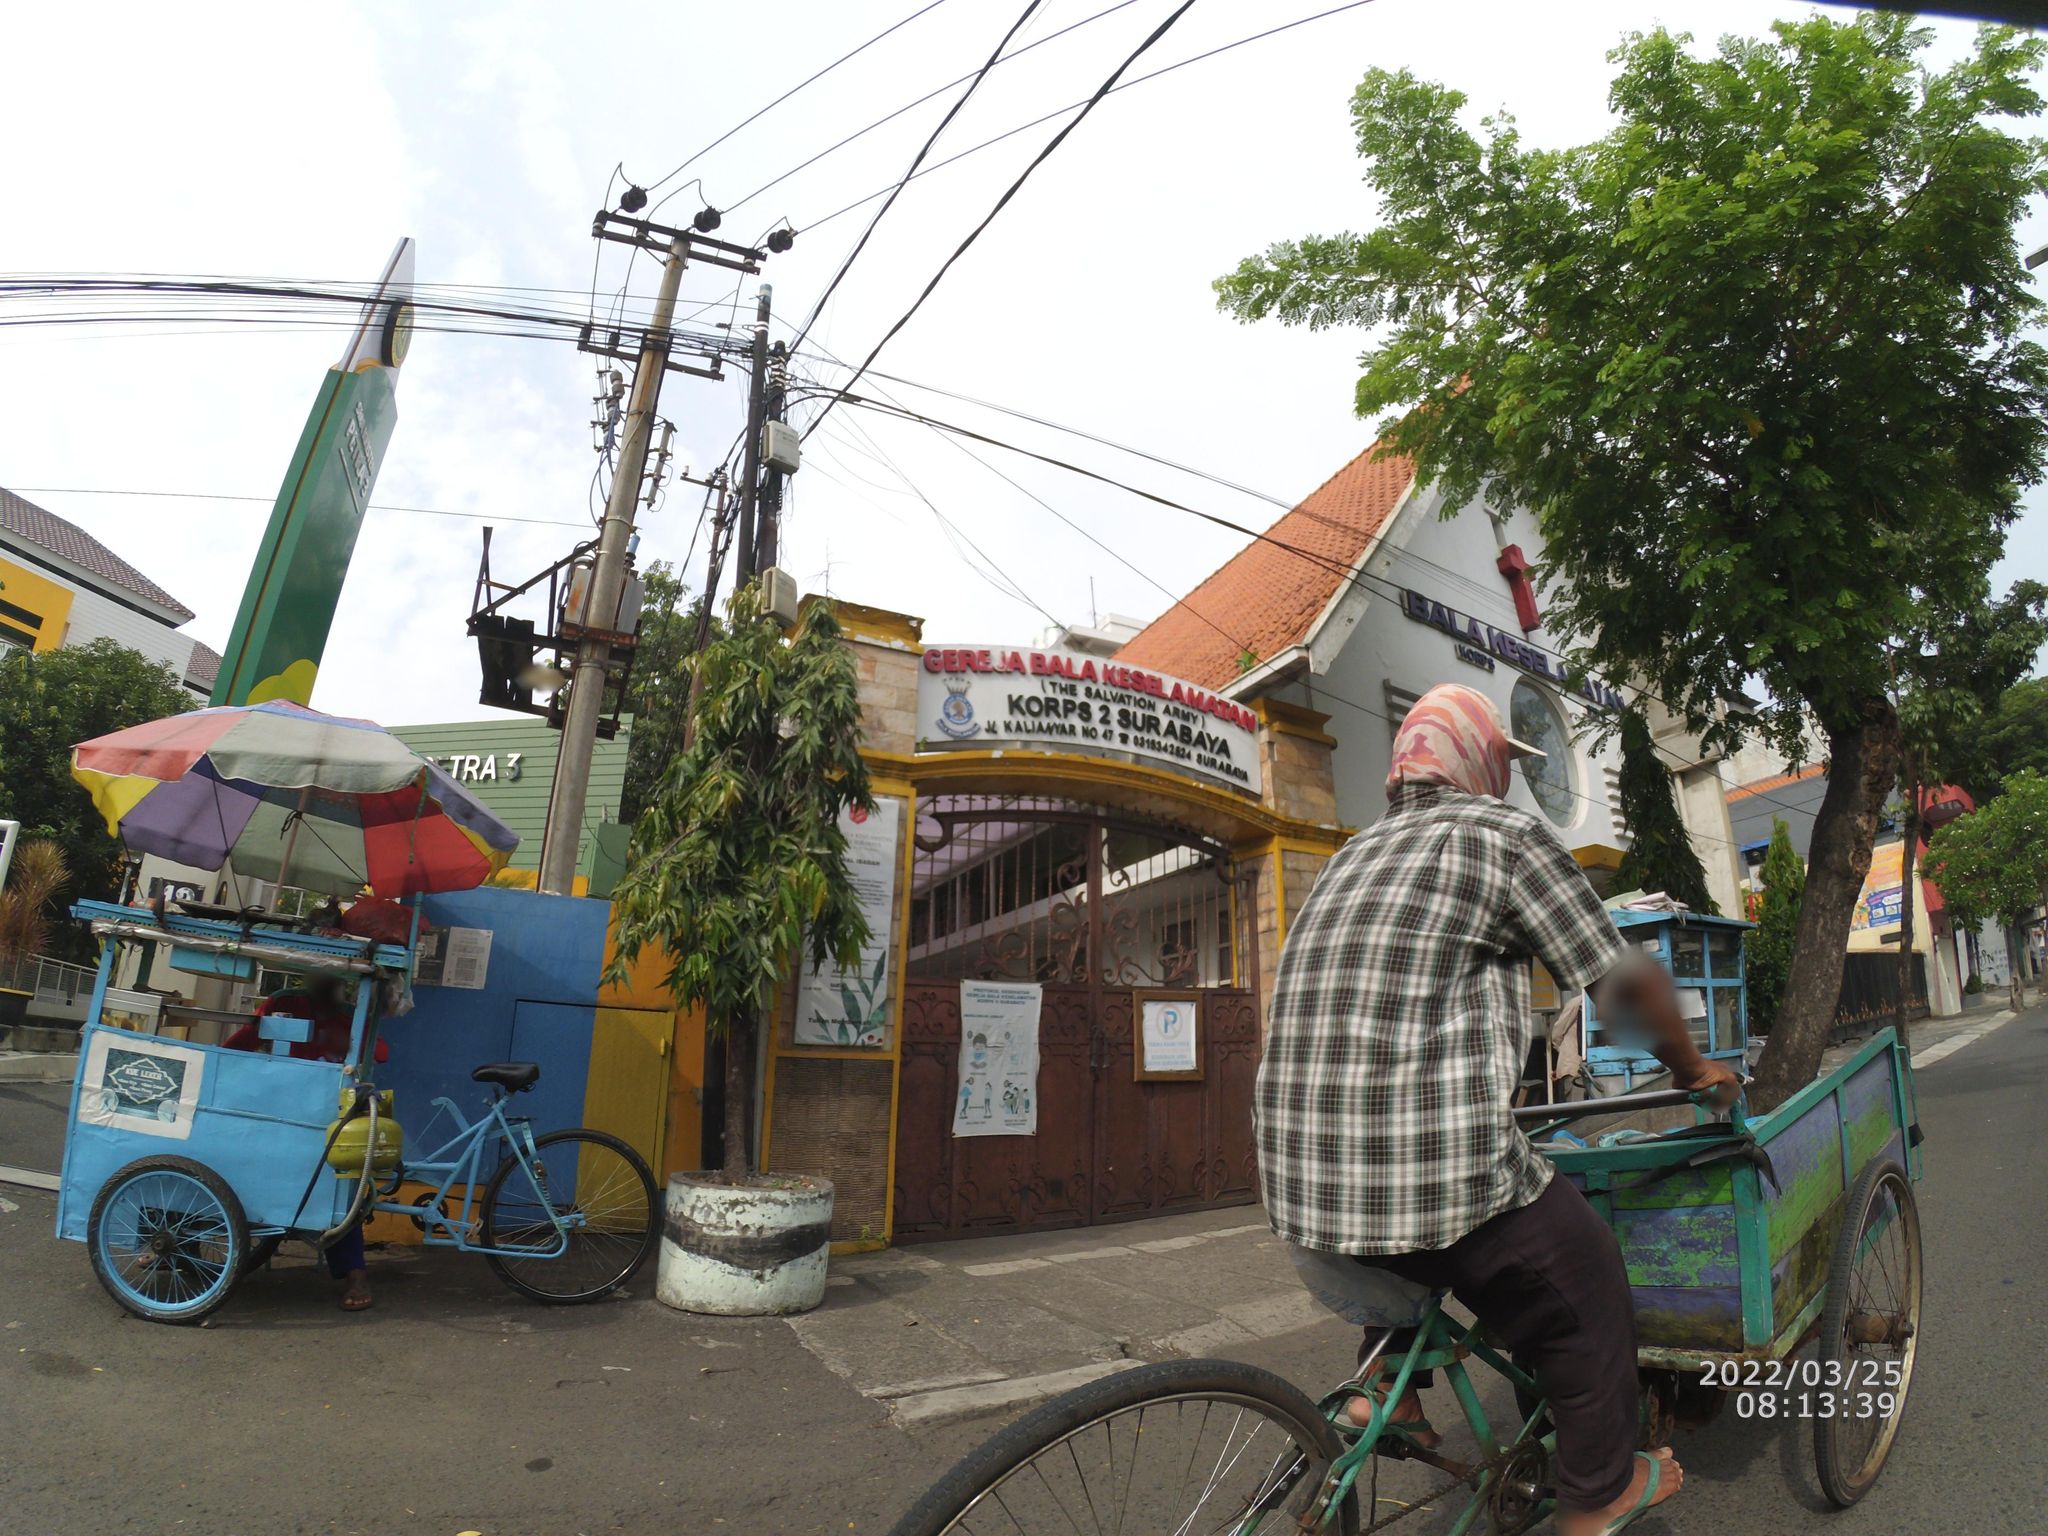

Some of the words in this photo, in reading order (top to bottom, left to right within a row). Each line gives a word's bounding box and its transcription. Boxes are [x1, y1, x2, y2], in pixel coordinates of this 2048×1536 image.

[1405, 590, 1486, 647] BALA
[923, 649, 1027, 675] GEREJA
[1030, 652, 1097, 683] BALA
[1102, 664, 1258, 733] KESELAMATAN
[1084, 686, 1156, 712] SALVATION
[1004, 720, 1076, 736] KALIANYAR
[1081, 726, 1097, 739] NO
[1102, 729, 1113, 741] 47
[1196, 753, 1248, 782] SURABAYA
[1007, 694, 1092, 722] KORPS
[1099, 704, 1111, 725] 2
[1117, 708, 1231, 759] SURABAYA
[506, 753, 522, 780] 3
[1163, 1010, 1178, 1034] P
